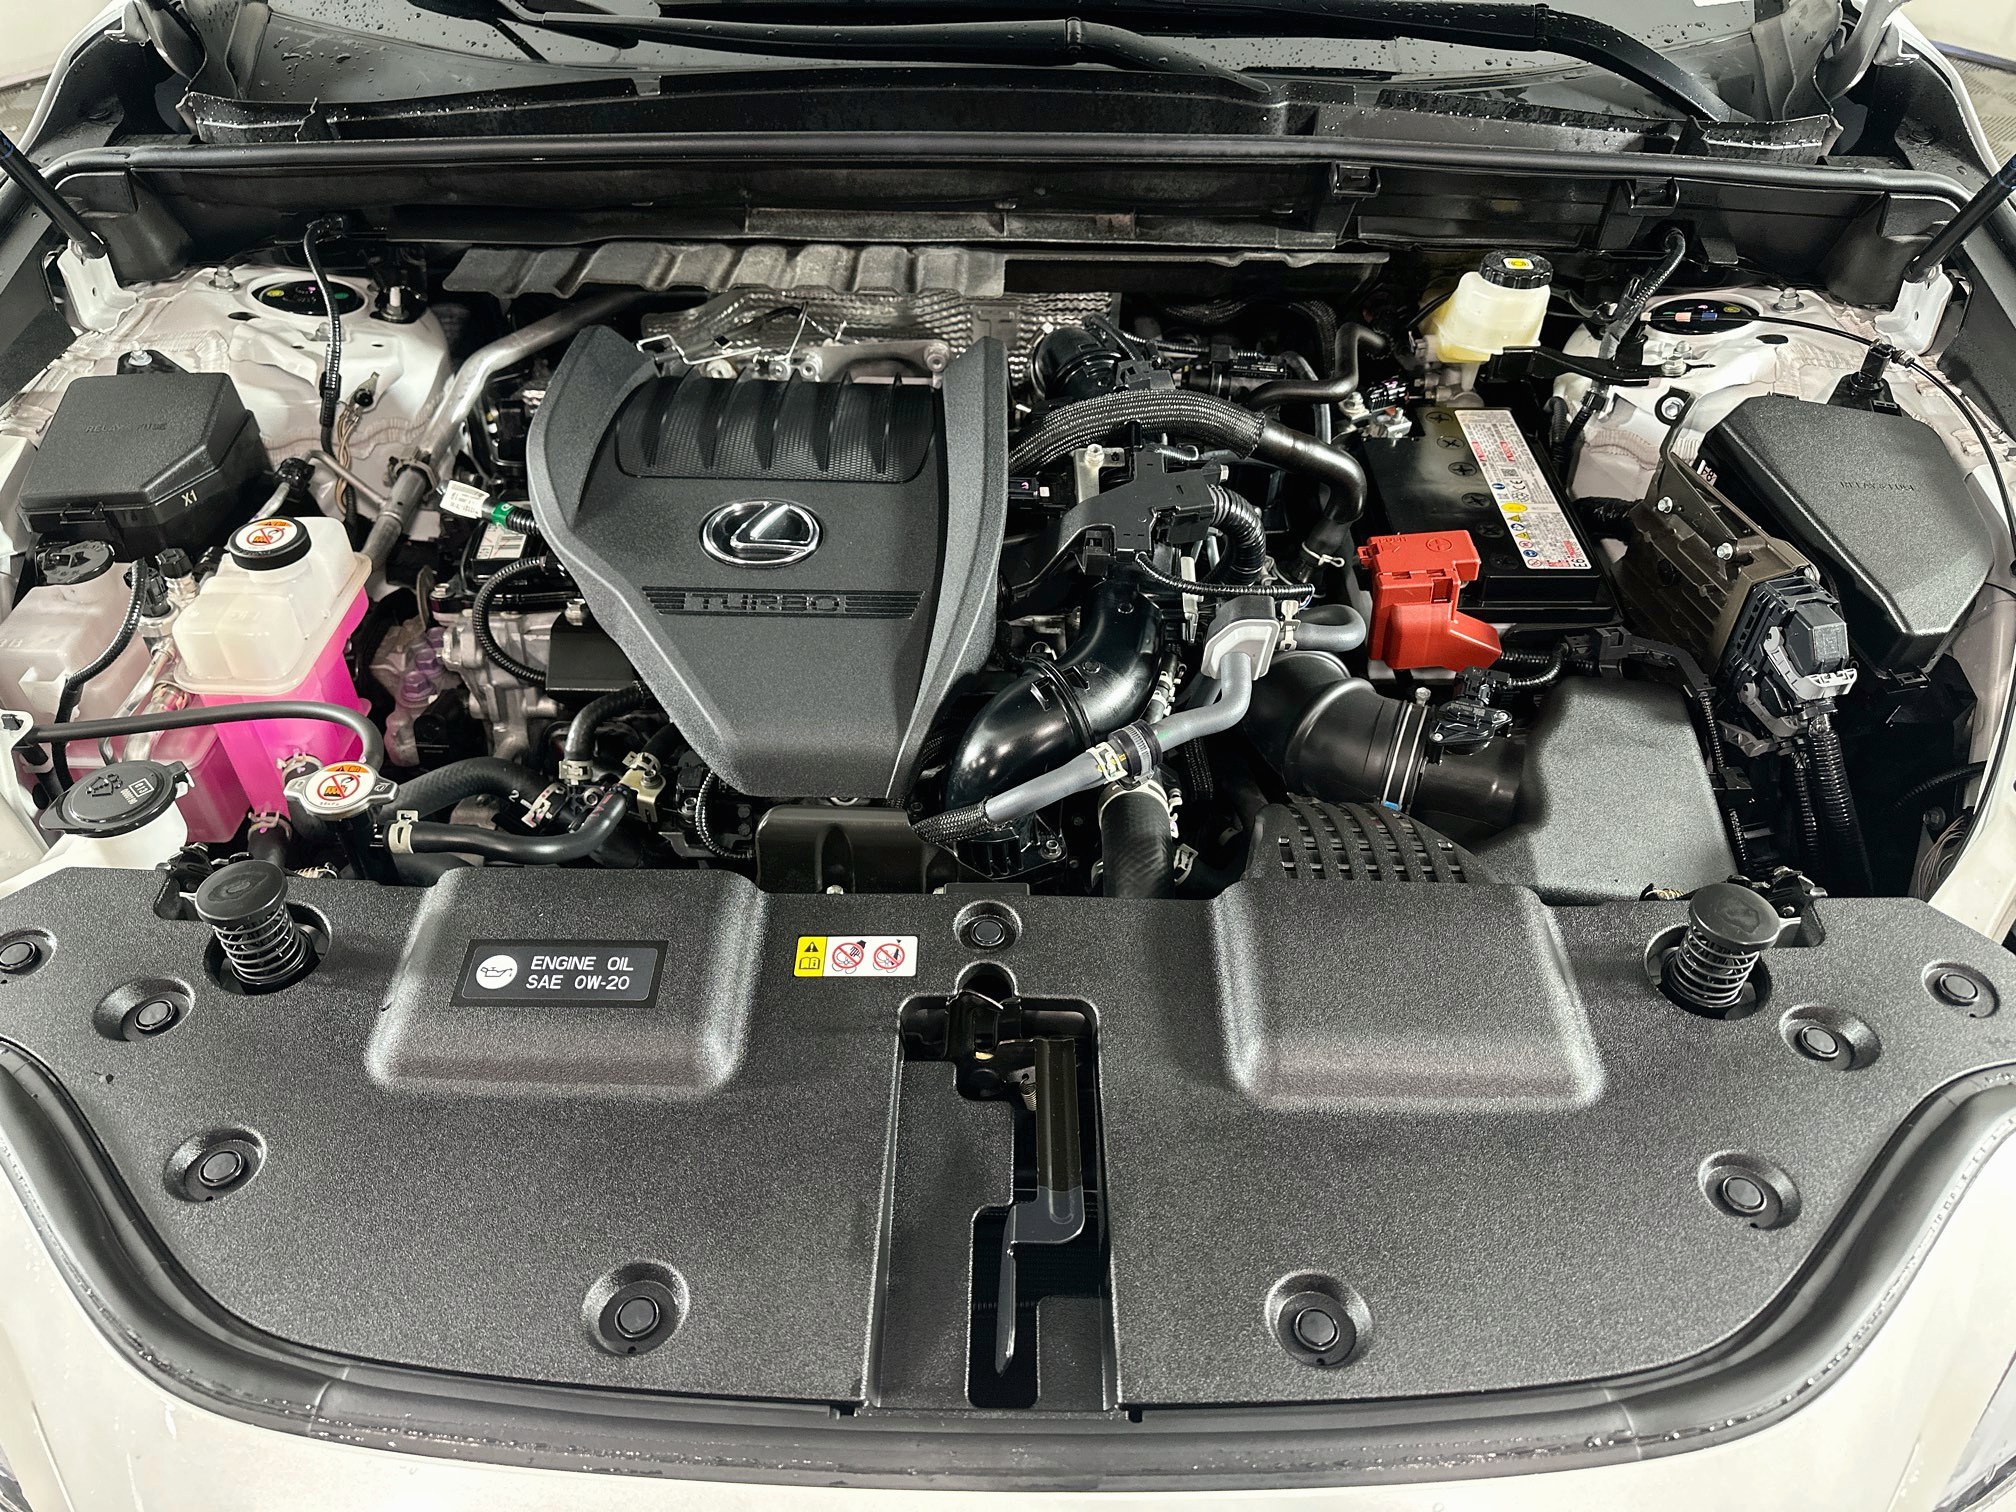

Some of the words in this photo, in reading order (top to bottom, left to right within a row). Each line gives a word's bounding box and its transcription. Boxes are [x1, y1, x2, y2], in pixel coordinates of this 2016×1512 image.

[180, 489, 199, 507] X1
[690, 592, 841, 612] TURBO
[530, 955, 597, 971] ENGINE
[607, 956, 634, 971] OIL
[525, 974, 564, 989] SAE
[574, 975, 630, 990] 0W-20
